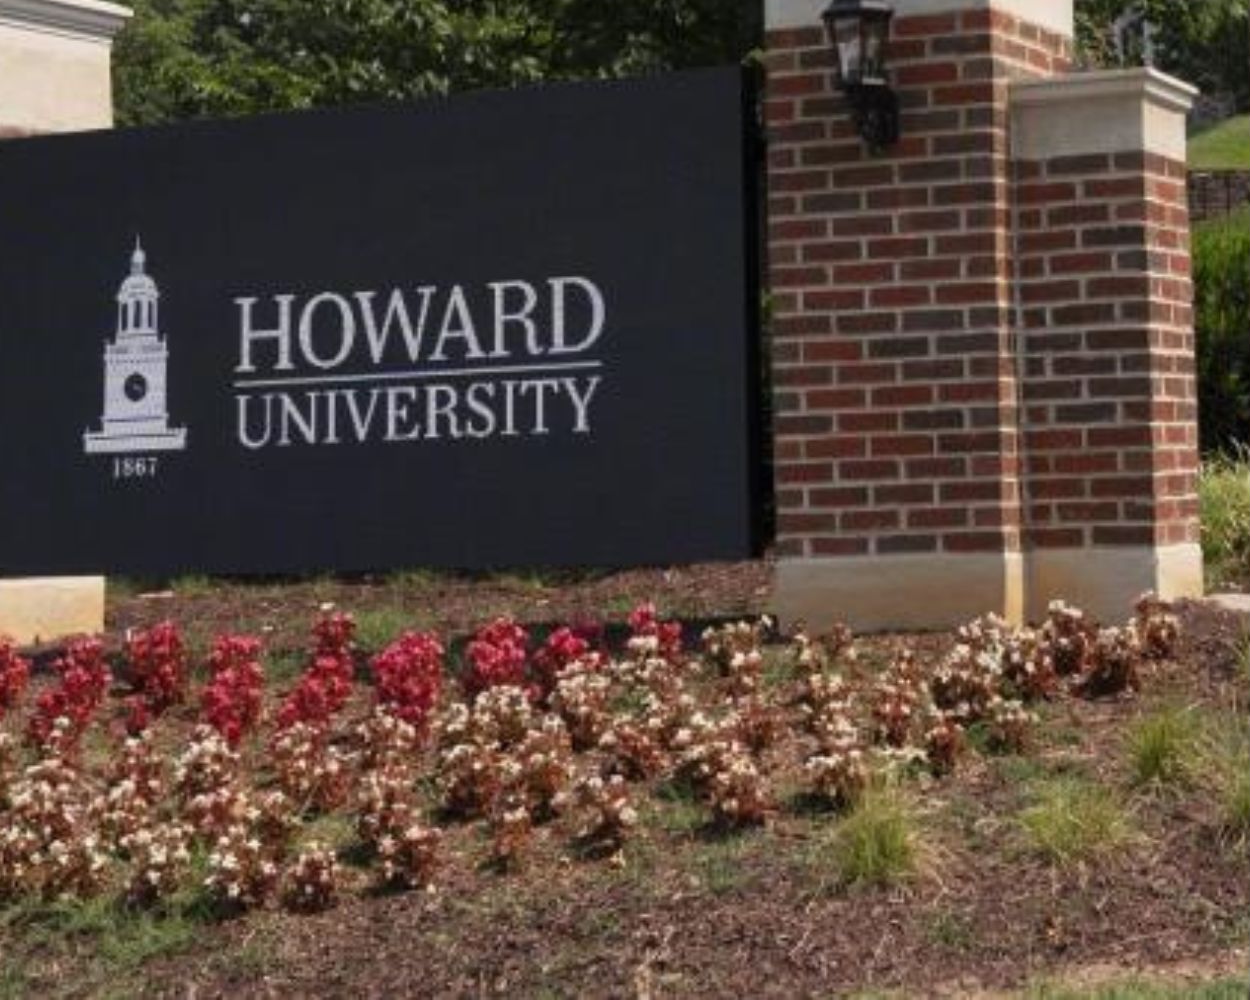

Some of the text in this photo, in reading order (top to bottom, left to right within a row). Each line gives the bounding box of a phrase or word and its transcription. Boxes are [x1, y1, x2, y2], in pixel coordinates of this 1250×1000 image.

[234, 276, 605, 373] HOWARD
[236, 377, 600, 449] UNIVERSITY
[112, 456, 158, 478] 1867
